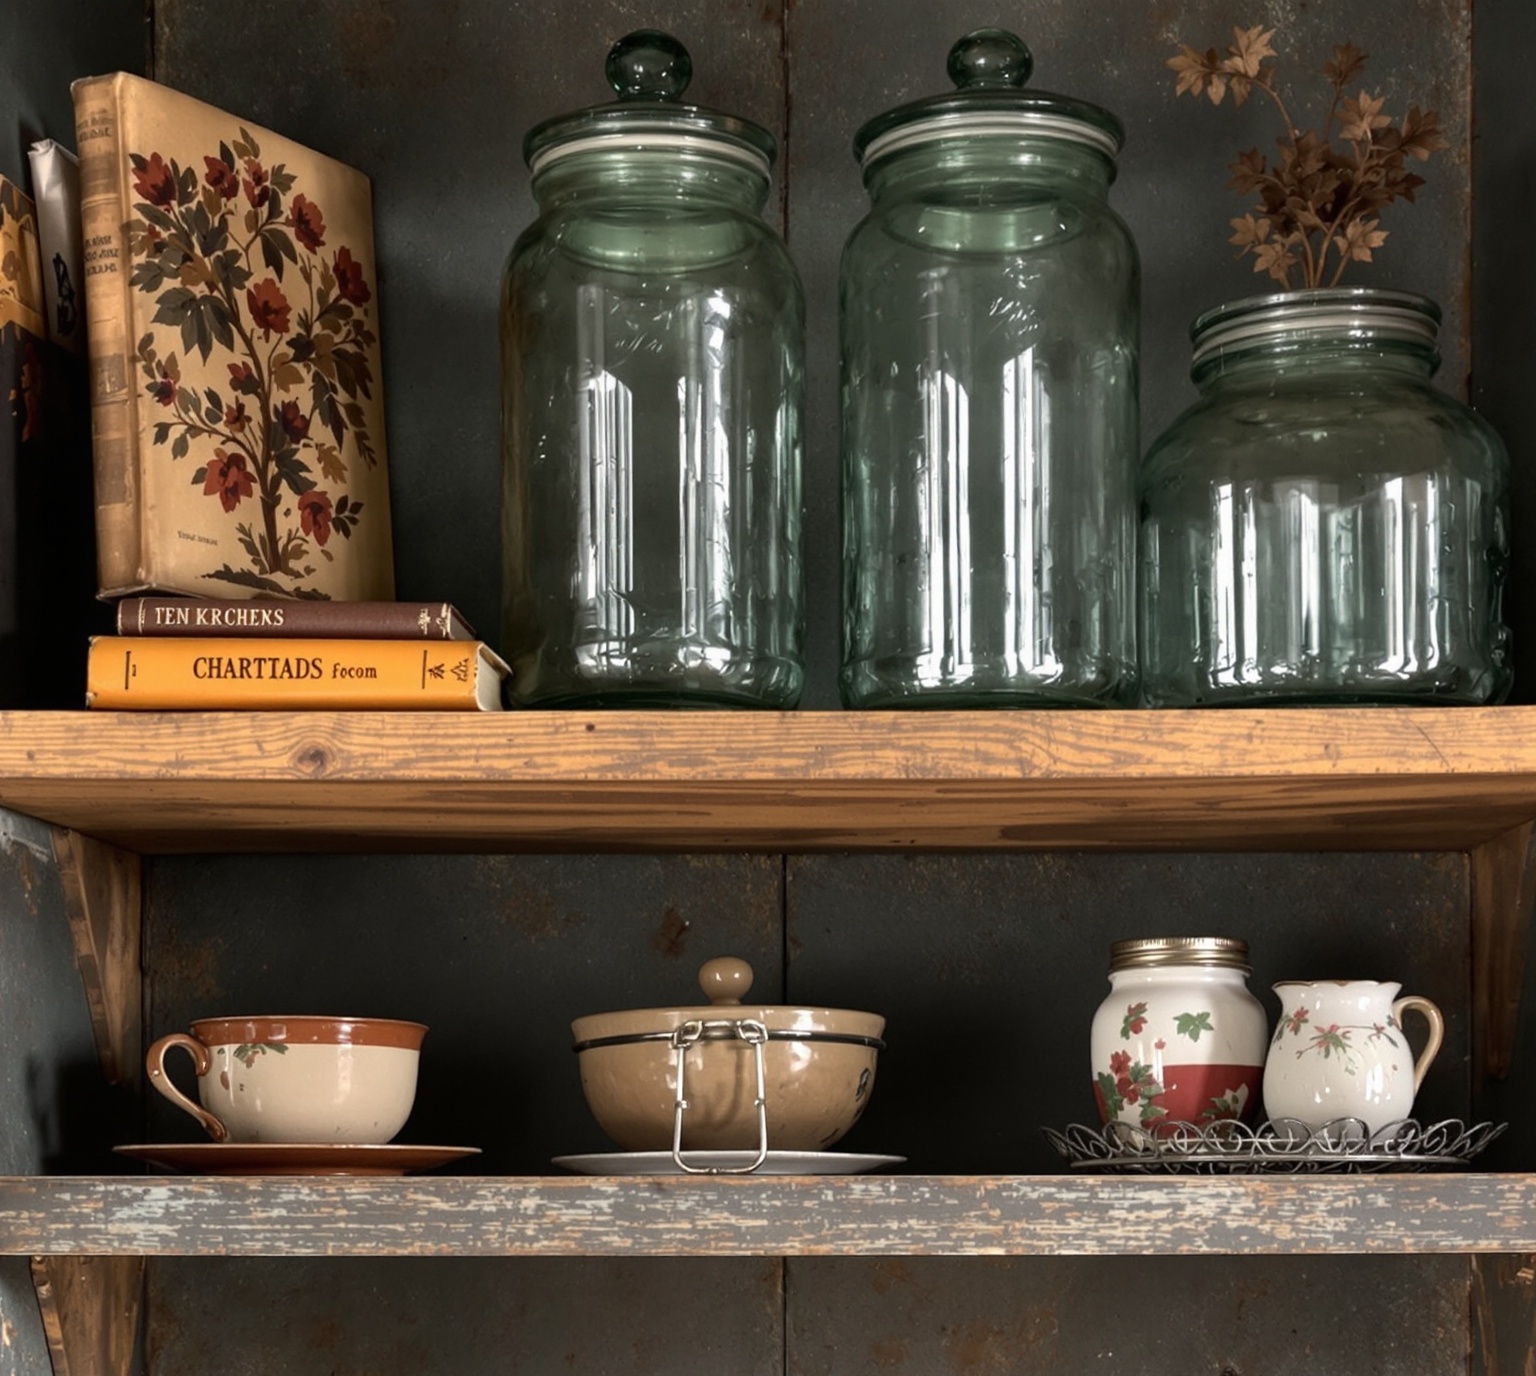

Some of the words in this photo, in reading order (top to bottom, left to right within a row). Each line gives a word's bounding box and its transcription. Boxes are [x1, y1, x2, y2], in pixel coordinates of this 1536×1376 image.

[155, 607, 190, 625] TEN
[193, 657, 323, 679] CHARTTADS
[332, 663, 377, 679] focom
